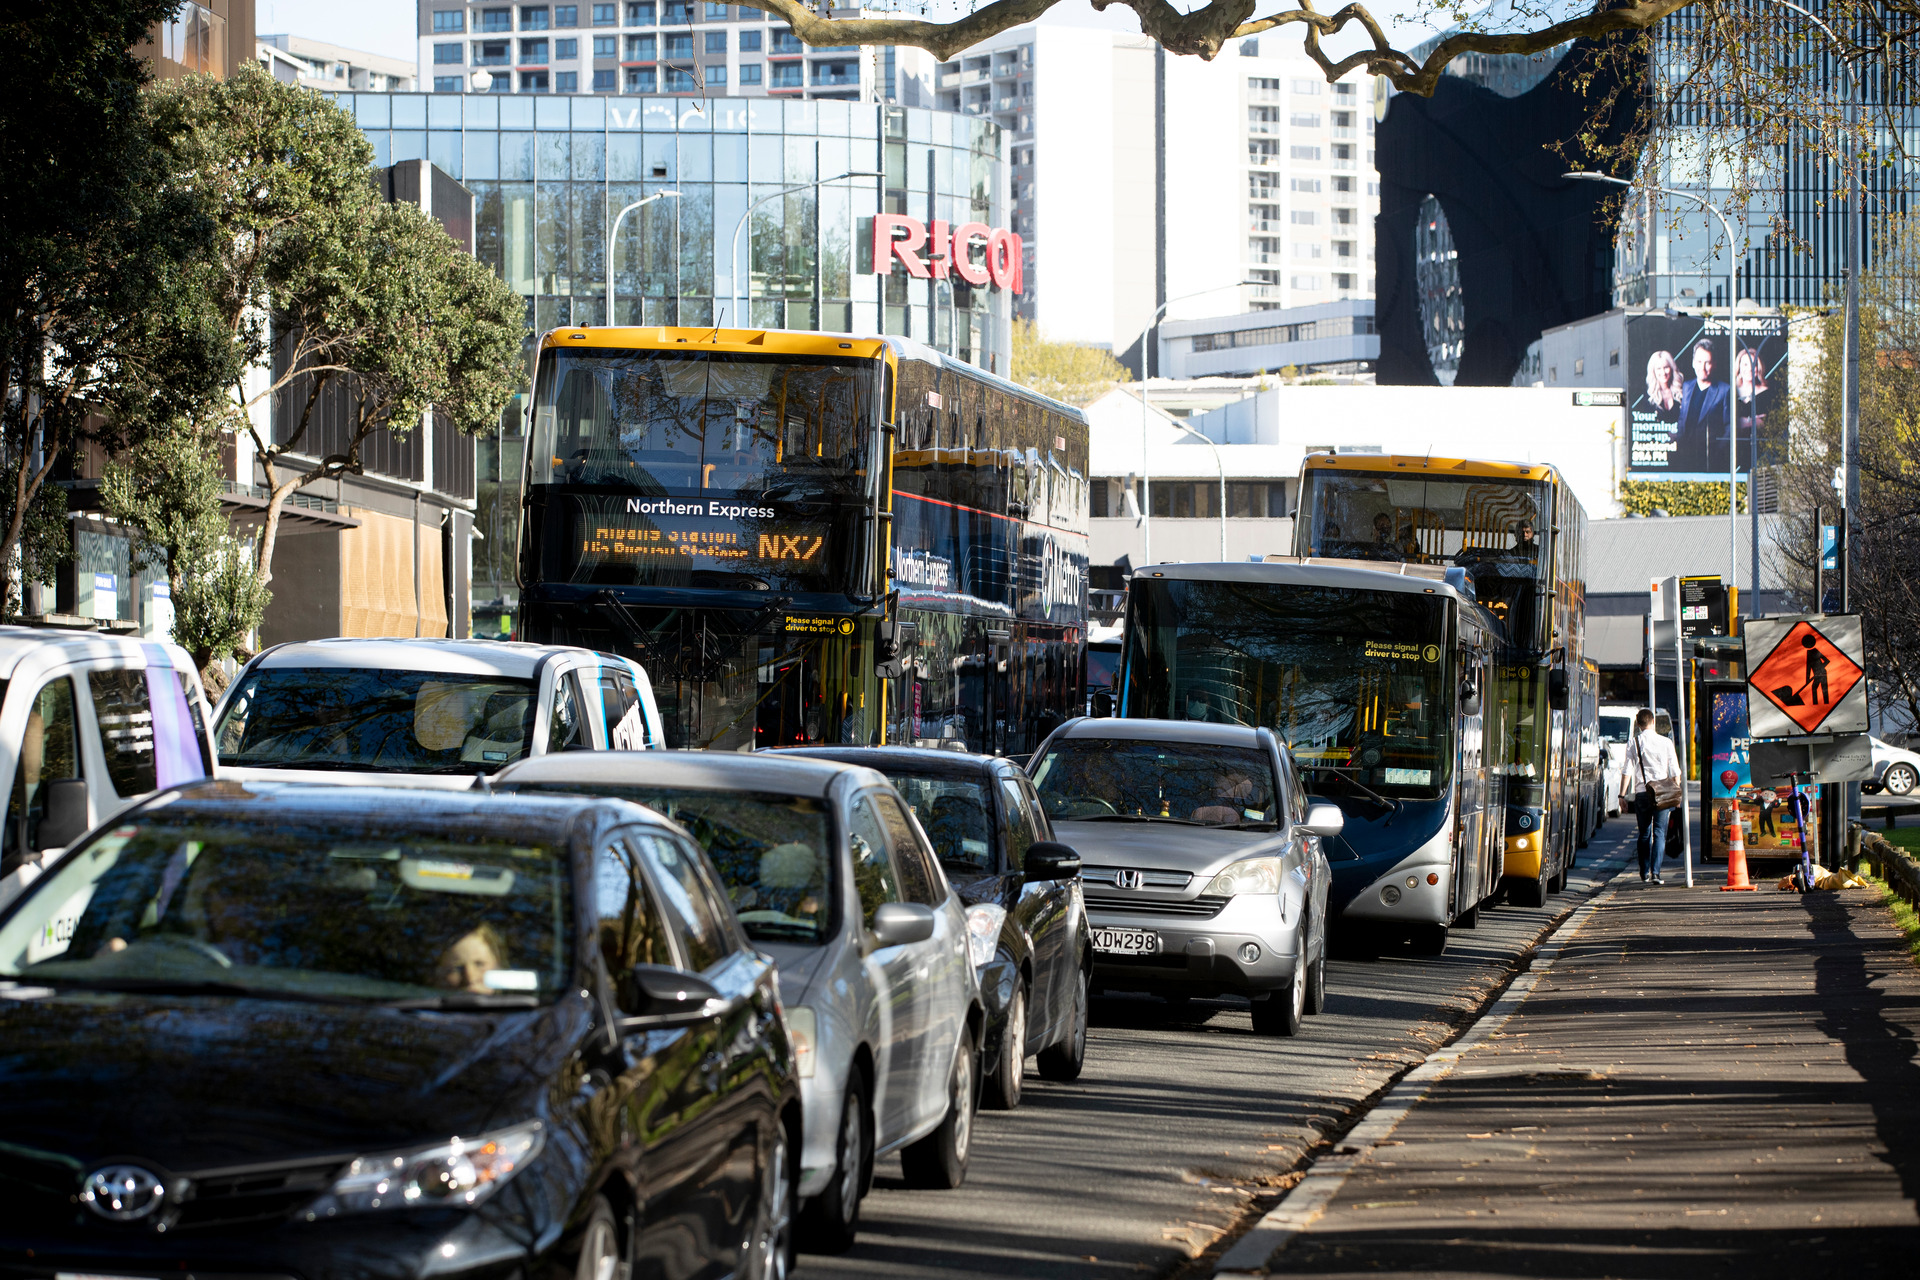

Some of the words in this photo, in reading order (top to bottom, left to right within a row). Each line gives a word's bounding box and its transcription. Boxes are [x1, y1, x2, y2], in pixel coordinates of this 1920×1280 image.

[872, 213, 1023, 295] RICO
[1632, 411, 1657, 421] Your
[1632, 421, 1678, 434] morning
[1631, 441, 1678, 452] Auckland
[626, 498, 703, 516] Northern
[709, 501, 775, 520] Express
[896, 546, 924, 584] Northern
[925, 551, 948, 594] Express
[1053, 543, 1080, 606] Metro
[785, 616, 810, 625] Please
[811, 617, 834, 627] signal
[785, 623, 808, 632] driver
[809, 624, 818, 632] to
[819, 625, 836, 635] stop
[1365, 641, 1392, 650] Please
[1393, 643, 1419, 653] signal
[1365, 649, 1390, 658] driver
[1401, 652, 1420, 662] stop
[1092, 930, 1155, 951] KDW298
